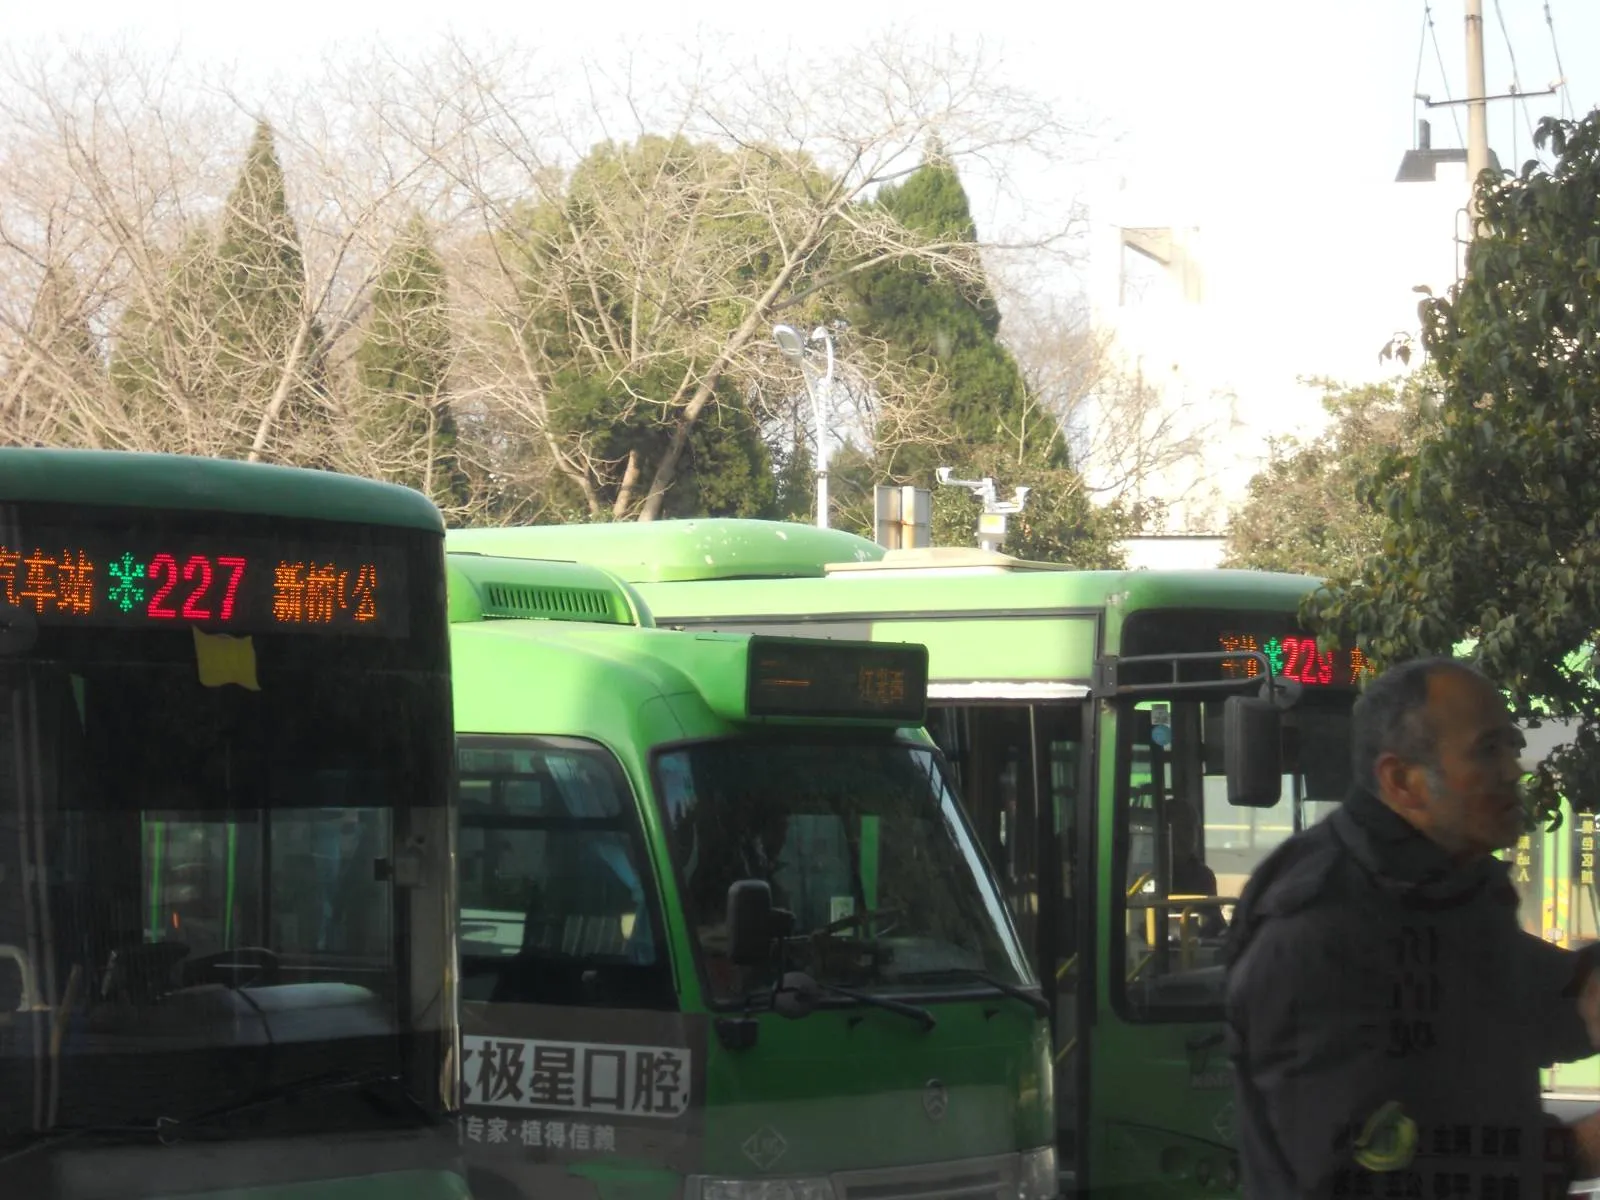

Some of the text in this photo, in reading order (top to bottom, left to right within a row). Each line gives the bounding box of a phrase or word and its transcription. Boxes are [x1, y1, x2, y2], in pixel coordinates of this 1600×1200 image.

[147, 553, 247, 620] 227
[463, 1040, 682, 1114] 极星口腔
